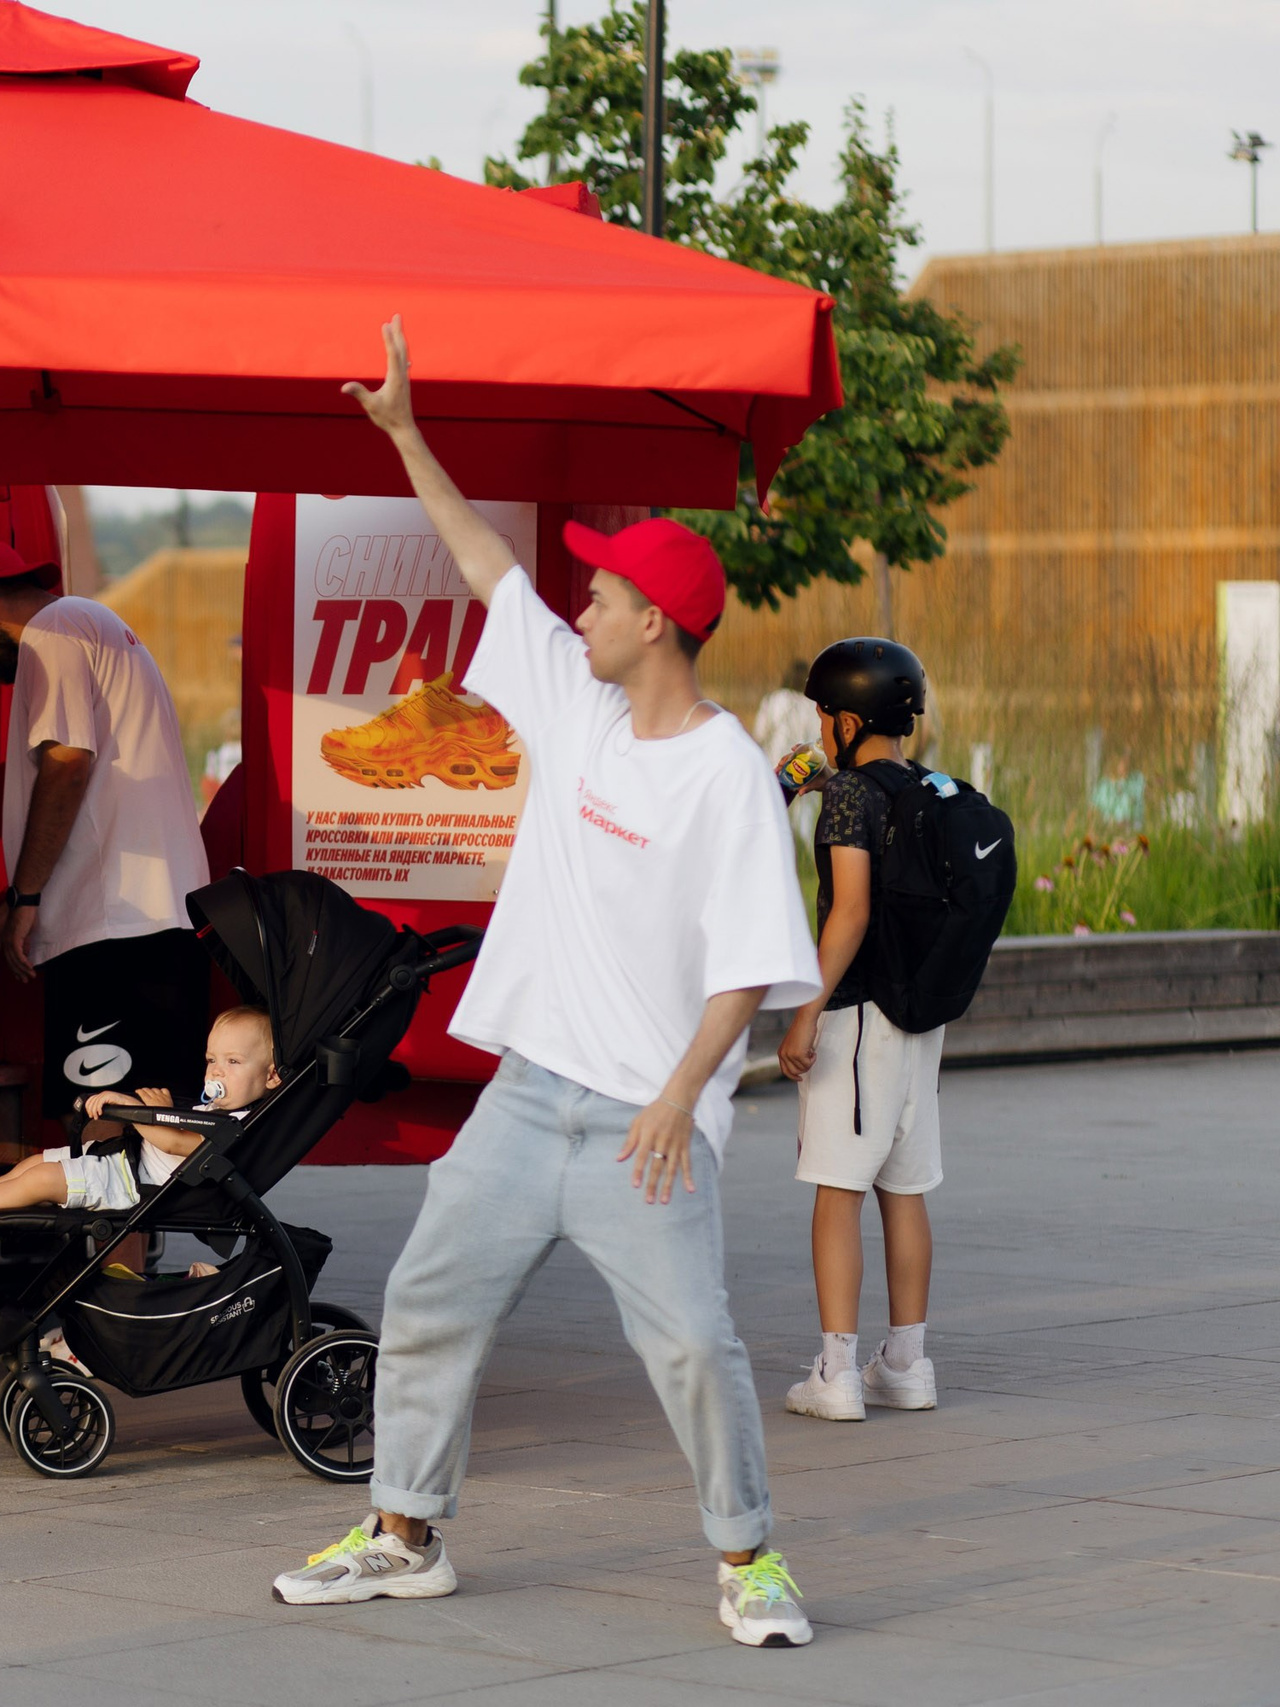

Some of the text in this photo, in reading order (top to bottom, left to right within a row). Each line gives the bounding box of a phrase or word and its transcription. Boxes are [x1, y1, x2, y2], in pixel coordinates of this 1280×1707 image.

[306, 811, 517, 829] У НАС МОЖНО КУПИТЬ ОРИГИНАЛЬНЫЕ
[579, 805, 651, 849] Маркет
[305, 830, 369, 844] КРОССОВКИ
[370, 830, 393, 845] ИЛИ
[394, 831, 451, 846] ПРИНЕСТИ
[305, 848, 486, 867] КУПЛЕННЫЕ НА ЯНДЕКС МАРКЕТЕ,
[317, 866, 392, 882] ЗАКАСТОМИТЬ
[394, 868, 410, 882] ИХ
[156, 1113, 180, 1124] VENGA
